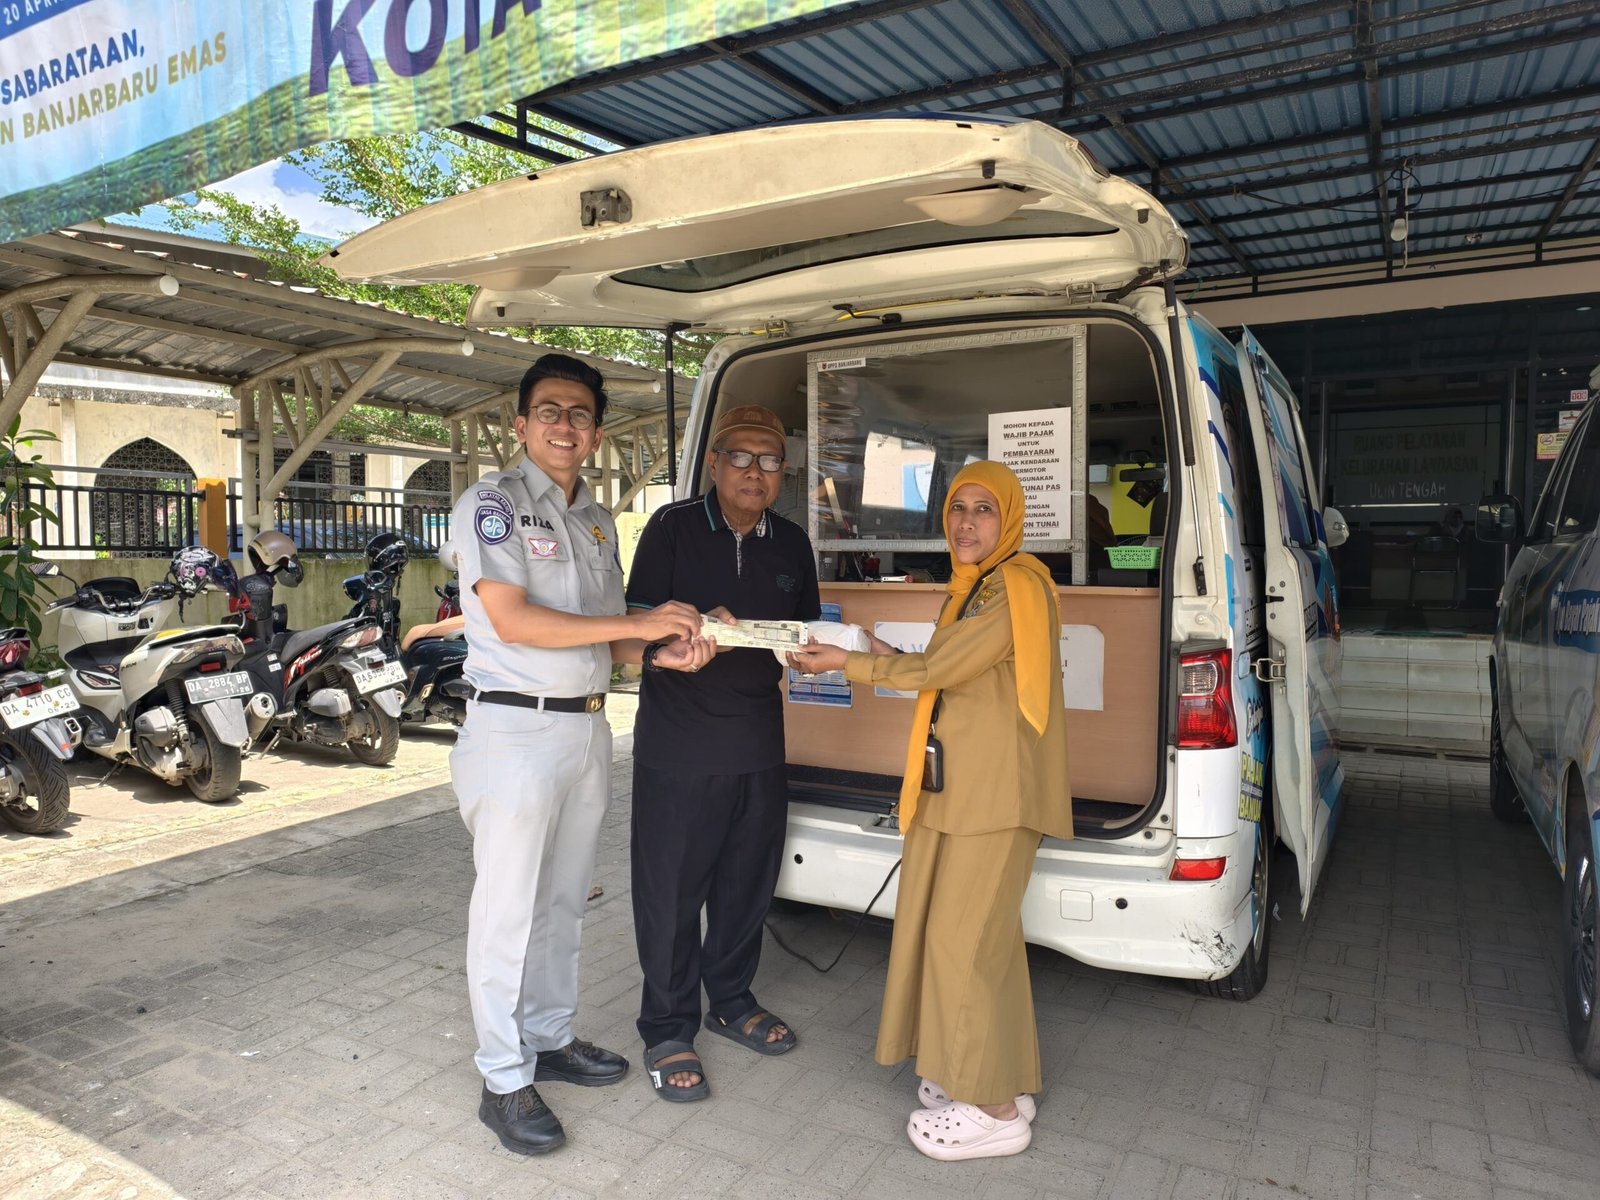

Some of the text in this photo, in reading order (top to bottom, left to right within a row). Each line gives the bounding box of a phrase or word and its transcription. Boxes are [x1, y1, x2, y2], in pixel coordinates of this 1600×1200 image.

[3, 0, 65, 25] 20 APR
[0, 28, 145, 105] SABARATAAN,
[22, 63, 158, 139] BANJARBARU
[167, 31, 227, 85] EMAS
[1028, 420, 1054, 428] KEPADA
[1003, 429, 1054, 439] WAJIB PAJAK
[1003, 448, 1055, 458] PEMBAYARAN
[1020, 457, 1060, 465] KENDARAAN
[1399, 481, 1447, 498] TENGAH
[520, 515, 555, 531] RIZA
[1036, 520, 1060, 528] TUNAI
[188, 674, 248, 692] DA 2884 BP
[2, 703, 20, 716] DA
[26, 693, 53, 709] 4710
